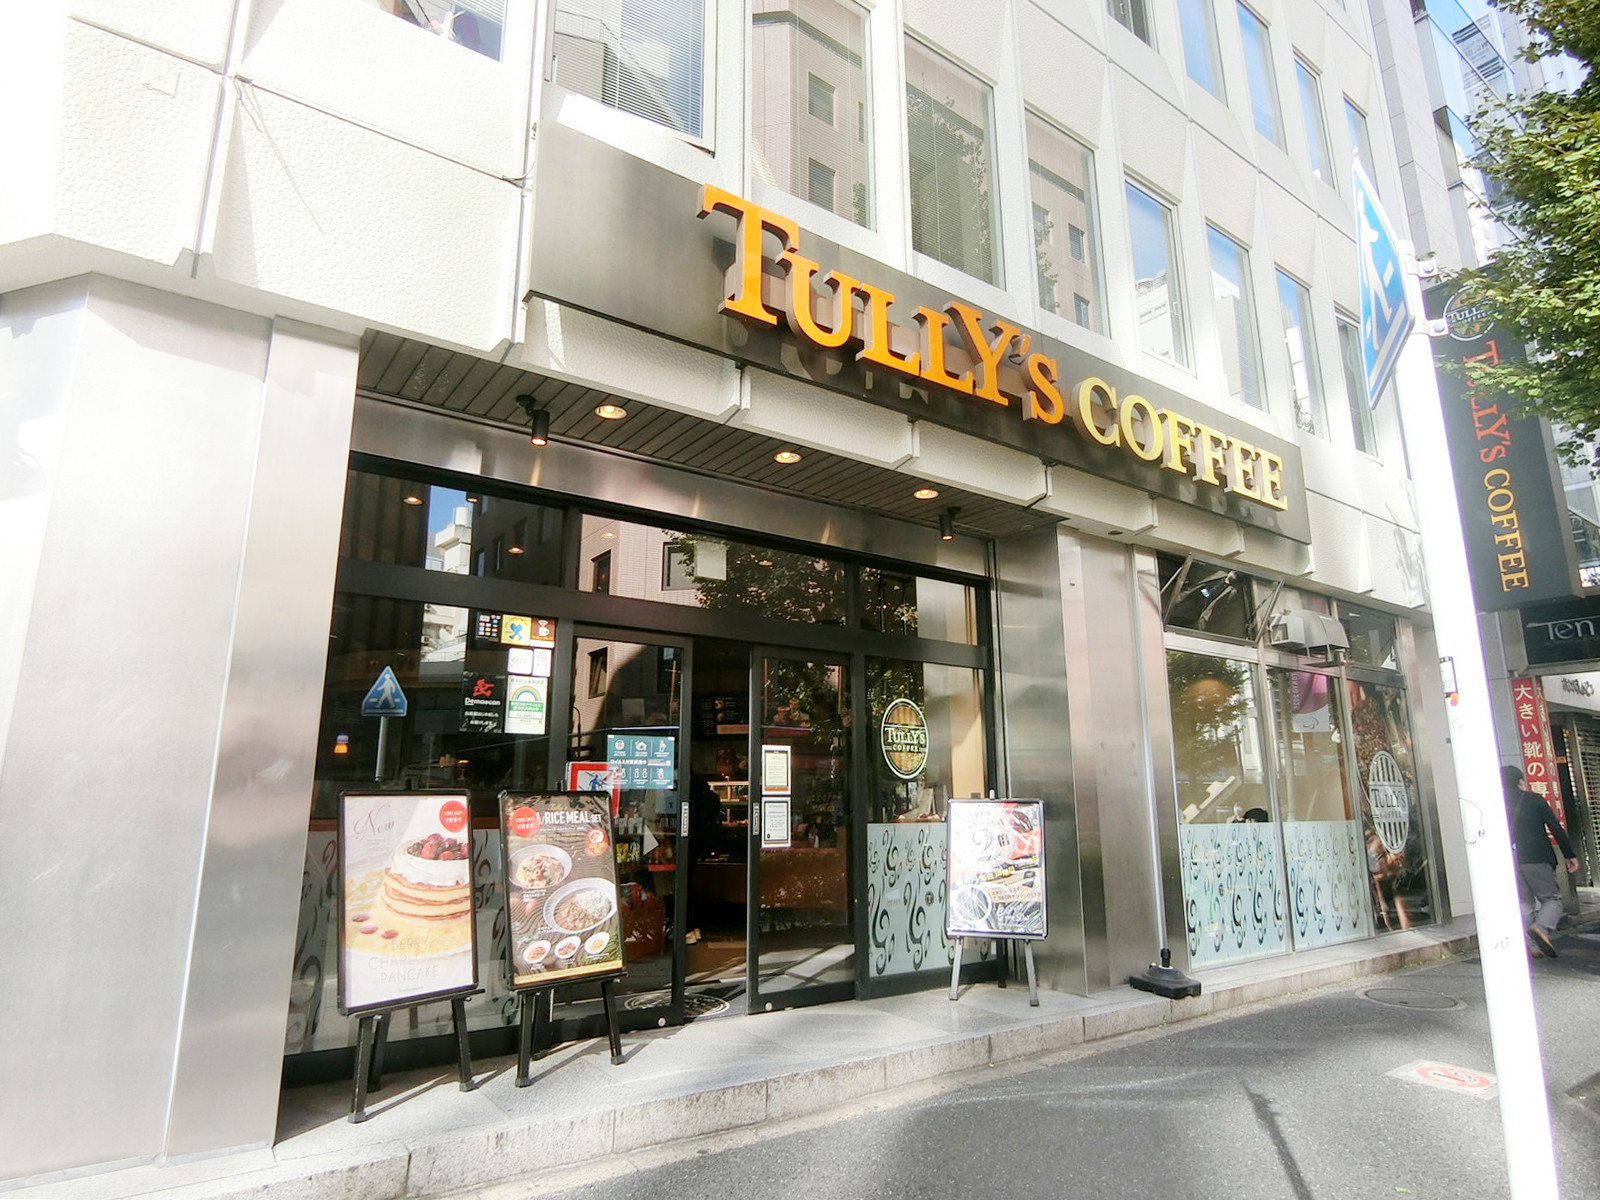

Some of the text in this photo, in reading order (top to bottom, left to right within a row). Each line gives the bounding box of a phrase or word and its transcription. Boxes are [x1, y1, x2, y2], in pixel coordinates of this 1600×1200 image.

[696, 184, 1289, 511] TULLY'S COFFEE
[1462, 340, 1530, 592] TLY'S COFFEE
[884, 727, 926, 745] TULLY'S
[892, 744, 919, 752] COFFEE
[1514, 684, 1554, 838] 大きい靴の専
[1370, 788, 1408, 809] TULLY'S
[566, 810, 590, 824] MEAL
[591, 813, 602, 823] SET
[1379, 810, 1402, 820] COFFEE
[380, 964, 439, 984] PANCAKE
